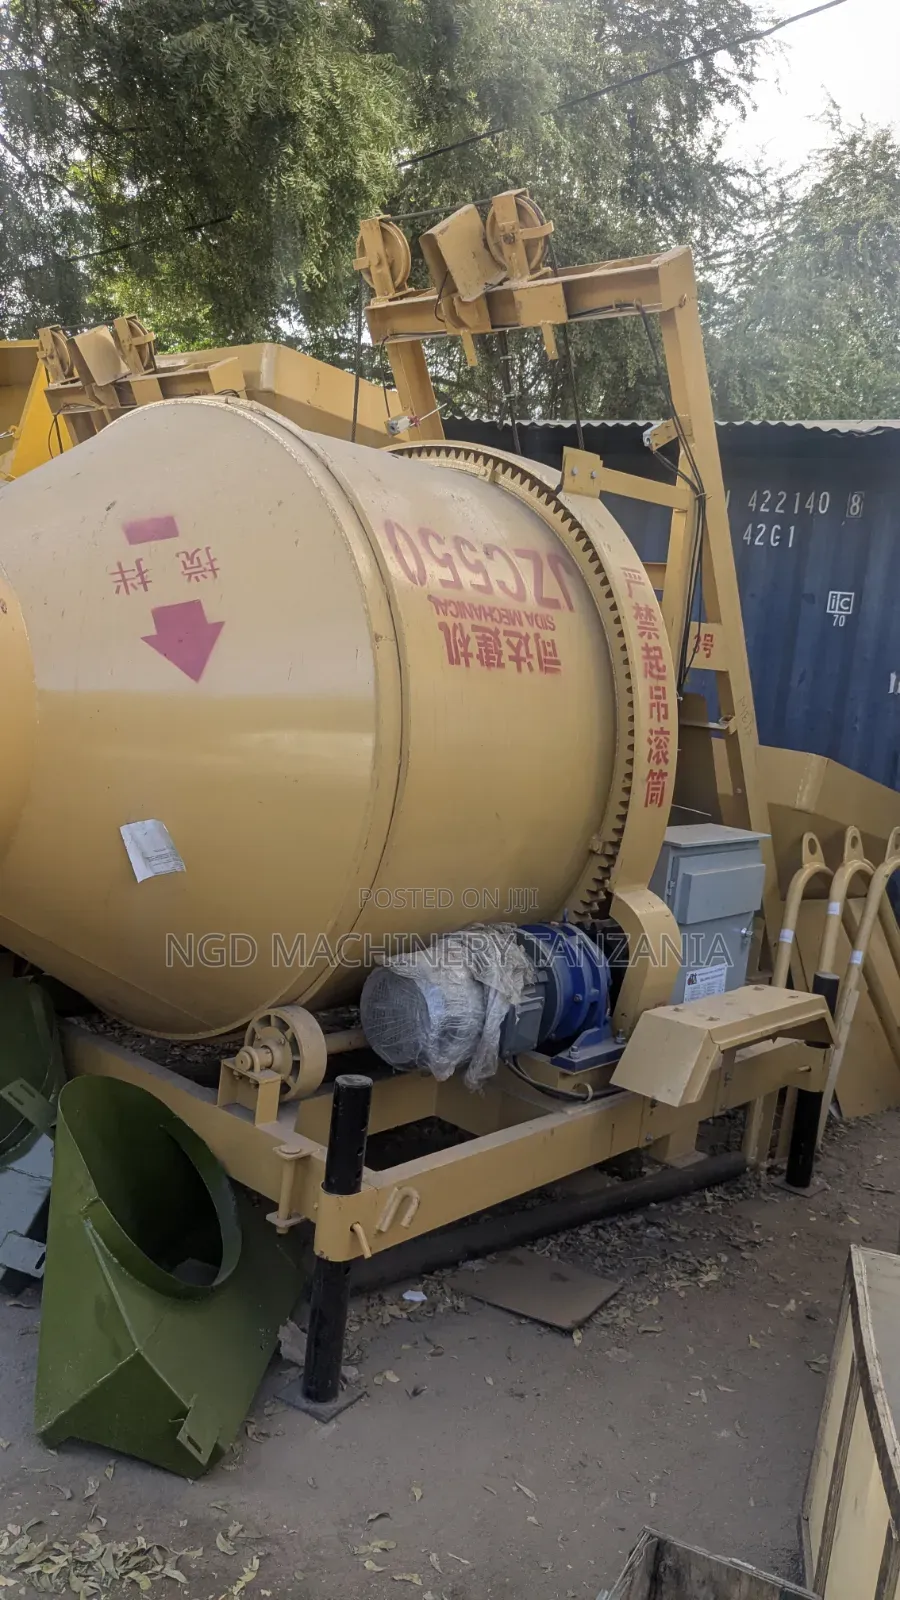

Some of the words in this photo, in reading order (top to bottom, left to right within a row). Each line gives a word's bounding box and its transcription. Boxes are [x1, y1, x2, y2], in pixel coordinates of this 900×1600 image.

[748, 490, 829, 514] 422140
[849, 493, 861, 516] 8
[743, 523, 795, 548] 42G1
[109, 546, 220, 596] 搅拌
[384, 518, 576, 613] JZC550
[427, 594, 522, 628] MECHANICAL
[523, 610, 556, 631] SIDA
[833, 615, 845, 627] 70
[438, 620, 562, 676] 司达建机
[620, 565, 671, 809] 严禁起吊滚筒
